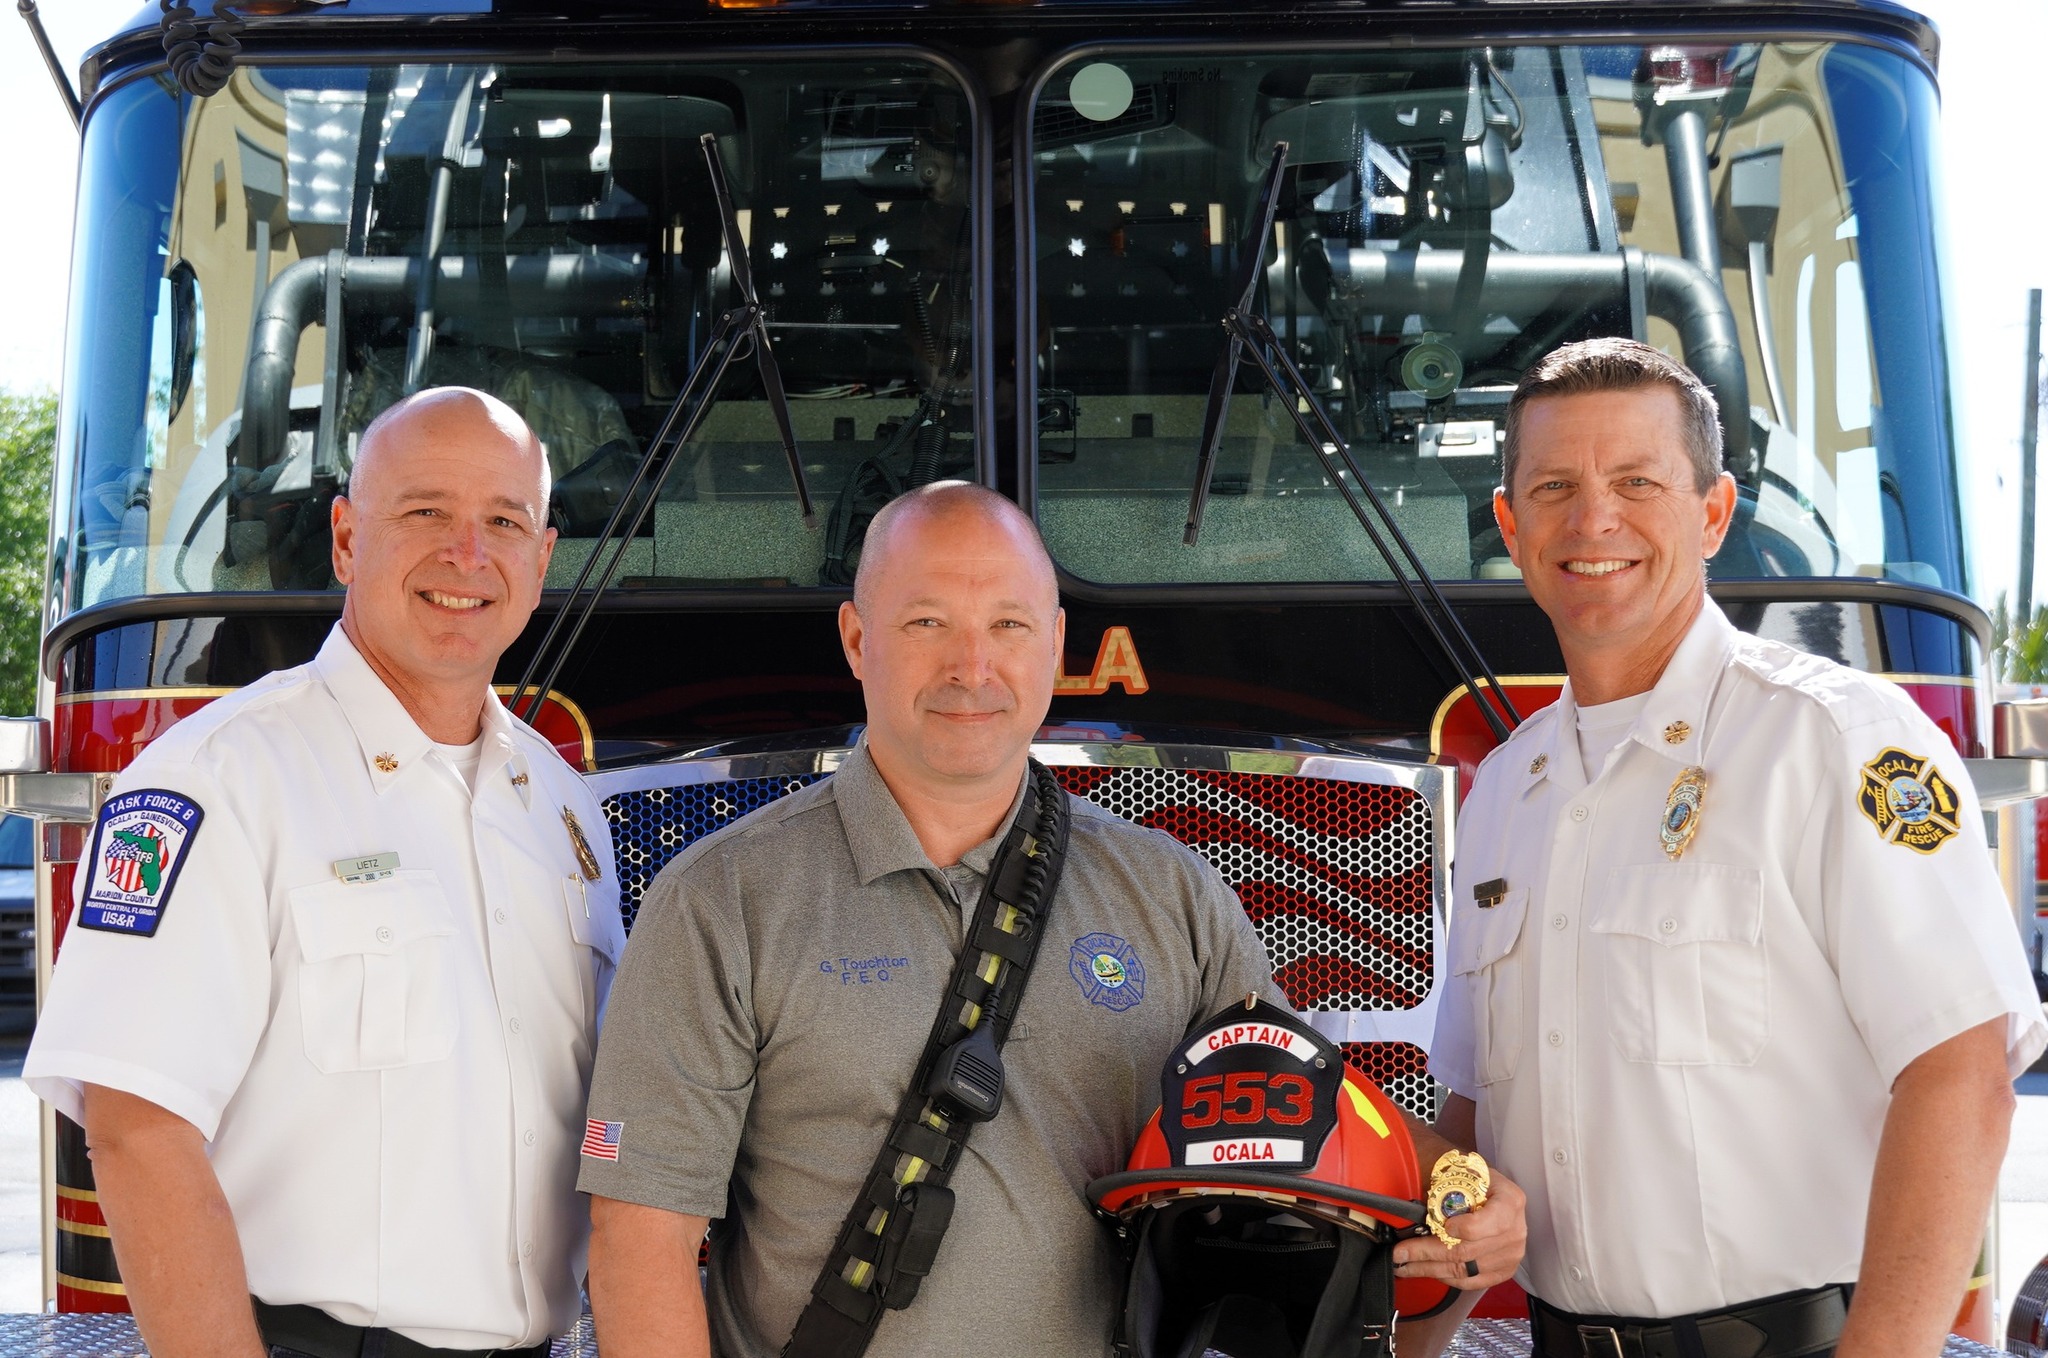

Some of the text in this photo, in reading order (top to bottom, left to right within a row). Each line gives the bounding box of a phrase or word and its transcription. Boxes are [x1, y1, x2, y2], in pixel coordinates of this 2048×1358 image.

[1877, 760, 1918, 777] OCALA
[108, 794, 194, 821] TASK FORCE 8
[108, 812, 185, 835] OCALA GAINESVILLE
[1907, 822, 1935, 835] FIRE
[1902, 828, 1945, 844] RESCUE
[118, 851, 154, 864] FL-TF8
[356, 859, 379, 870] LIETZ
[95, 890, 155, 904] MARION COUNTY
[105, 903, 131, 913] CENTRAL
[131, 907, 157, 916] FLORIDA
[101, 911, 136, 928] US&R
[819, 955, 909, 973] G. Touchton
[1102, 995, 1133, 1005] RESCUE
[1208, 1026, 1294, 1051] CAPTAIN
[1181, 1072, 1314, 1129] 553
[1213, 1142, 1274, 1162] OCALA
[1445, 1171, 1478, 1182] CAPTAIN
[1437, 1181, 1480, 1198] OCALA FIRE
